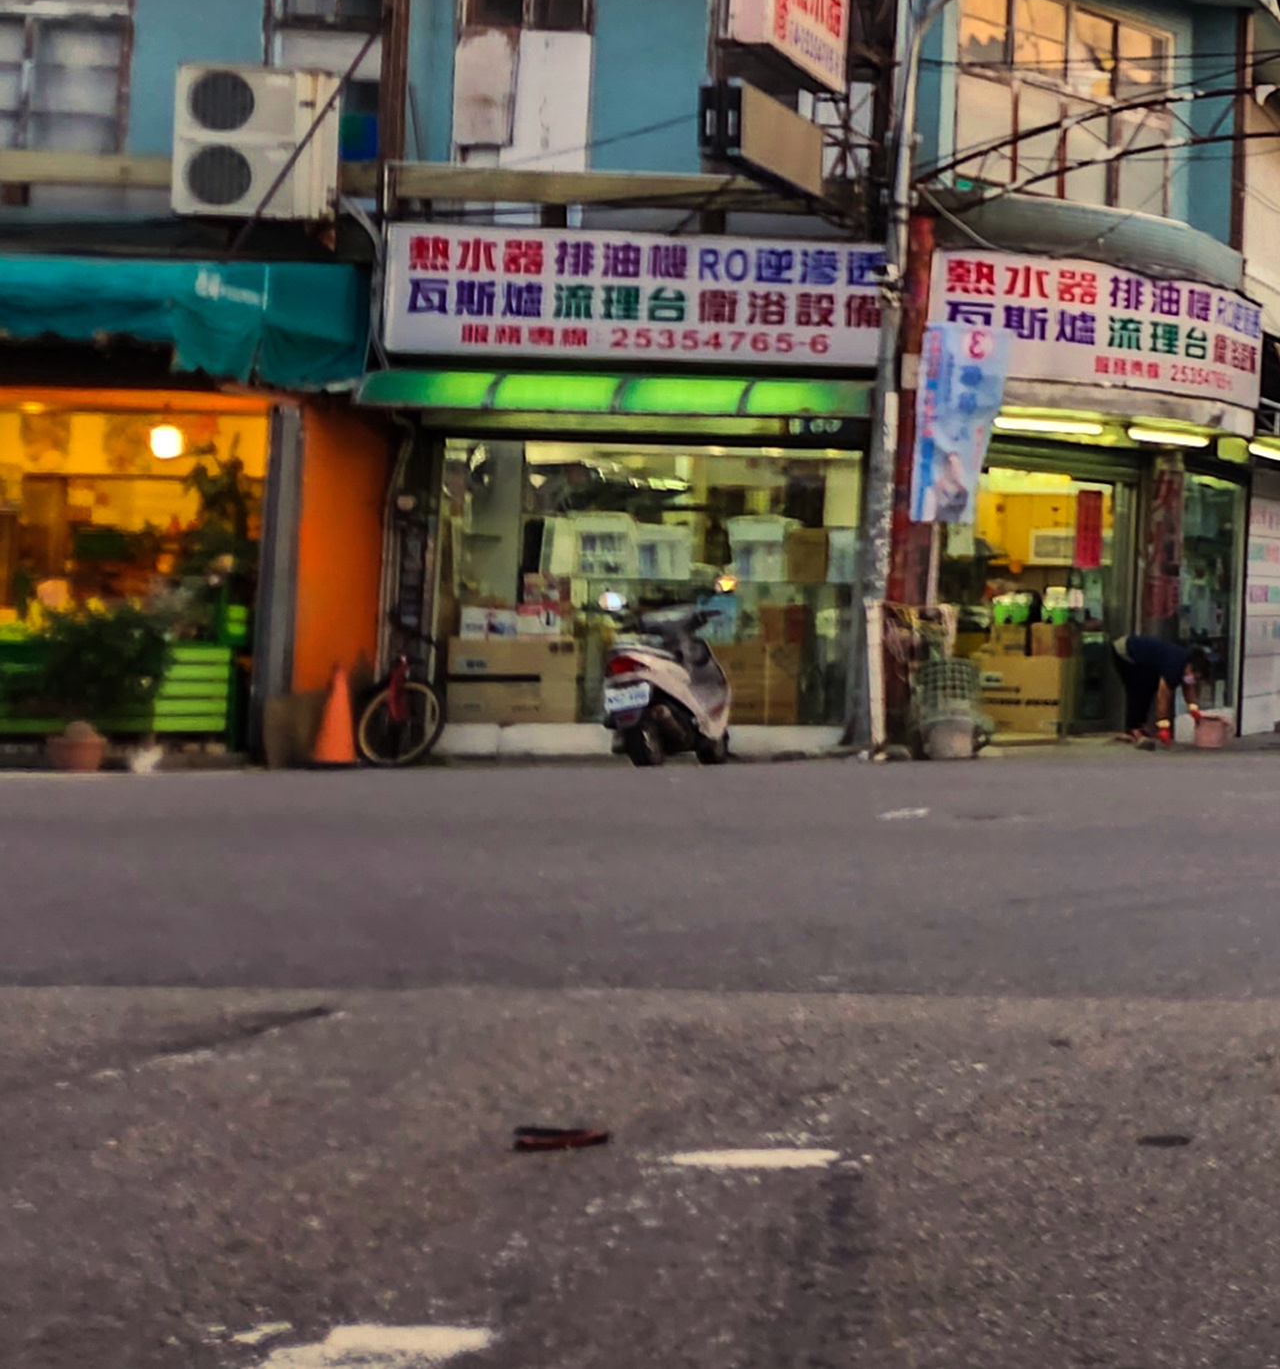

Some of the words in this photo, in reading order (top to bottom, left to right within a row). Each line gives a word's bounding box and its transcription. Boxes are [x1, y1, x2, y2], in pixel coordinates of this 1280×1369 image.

[408, 236, 544, 275] 熱水器
[555, 240, 688, 280] 排油機
[407, 278, 544, 319] 瓦斯爐
[552, 283, 686, 322] 流理台
[946, 258, 1098, 306] 熱水器
[1107, 315, 1208, 360] 流理台
